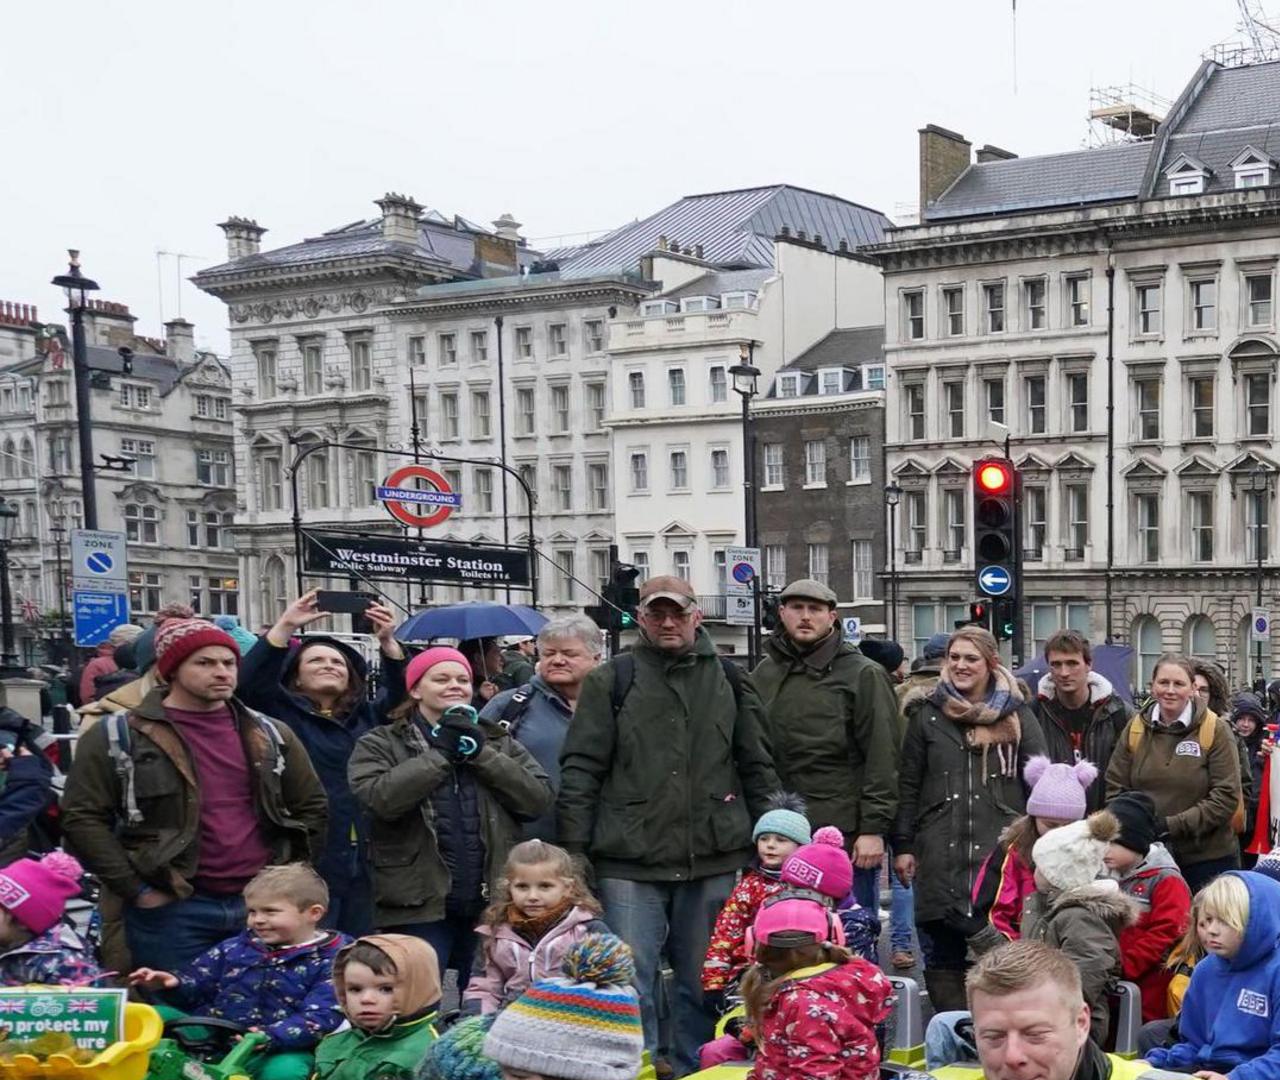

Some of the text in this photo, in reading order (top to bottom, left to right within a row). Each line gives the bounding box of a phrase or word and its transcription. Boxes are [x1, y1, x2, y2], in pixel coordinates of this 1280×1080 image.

[385, 490, 455, 503] UNDERGROUND
[84, 540, 114, 549] ZONE
[330, 560, 407, 575] Public Subway
[336, 549, 503, 572] Westminster Station
[460, 570, 491, 580] Toilets
[789, 860, 820, 881] BBF
[16, 1019, 81, 1034] protect
[84, 1020, 110, 1034] my
